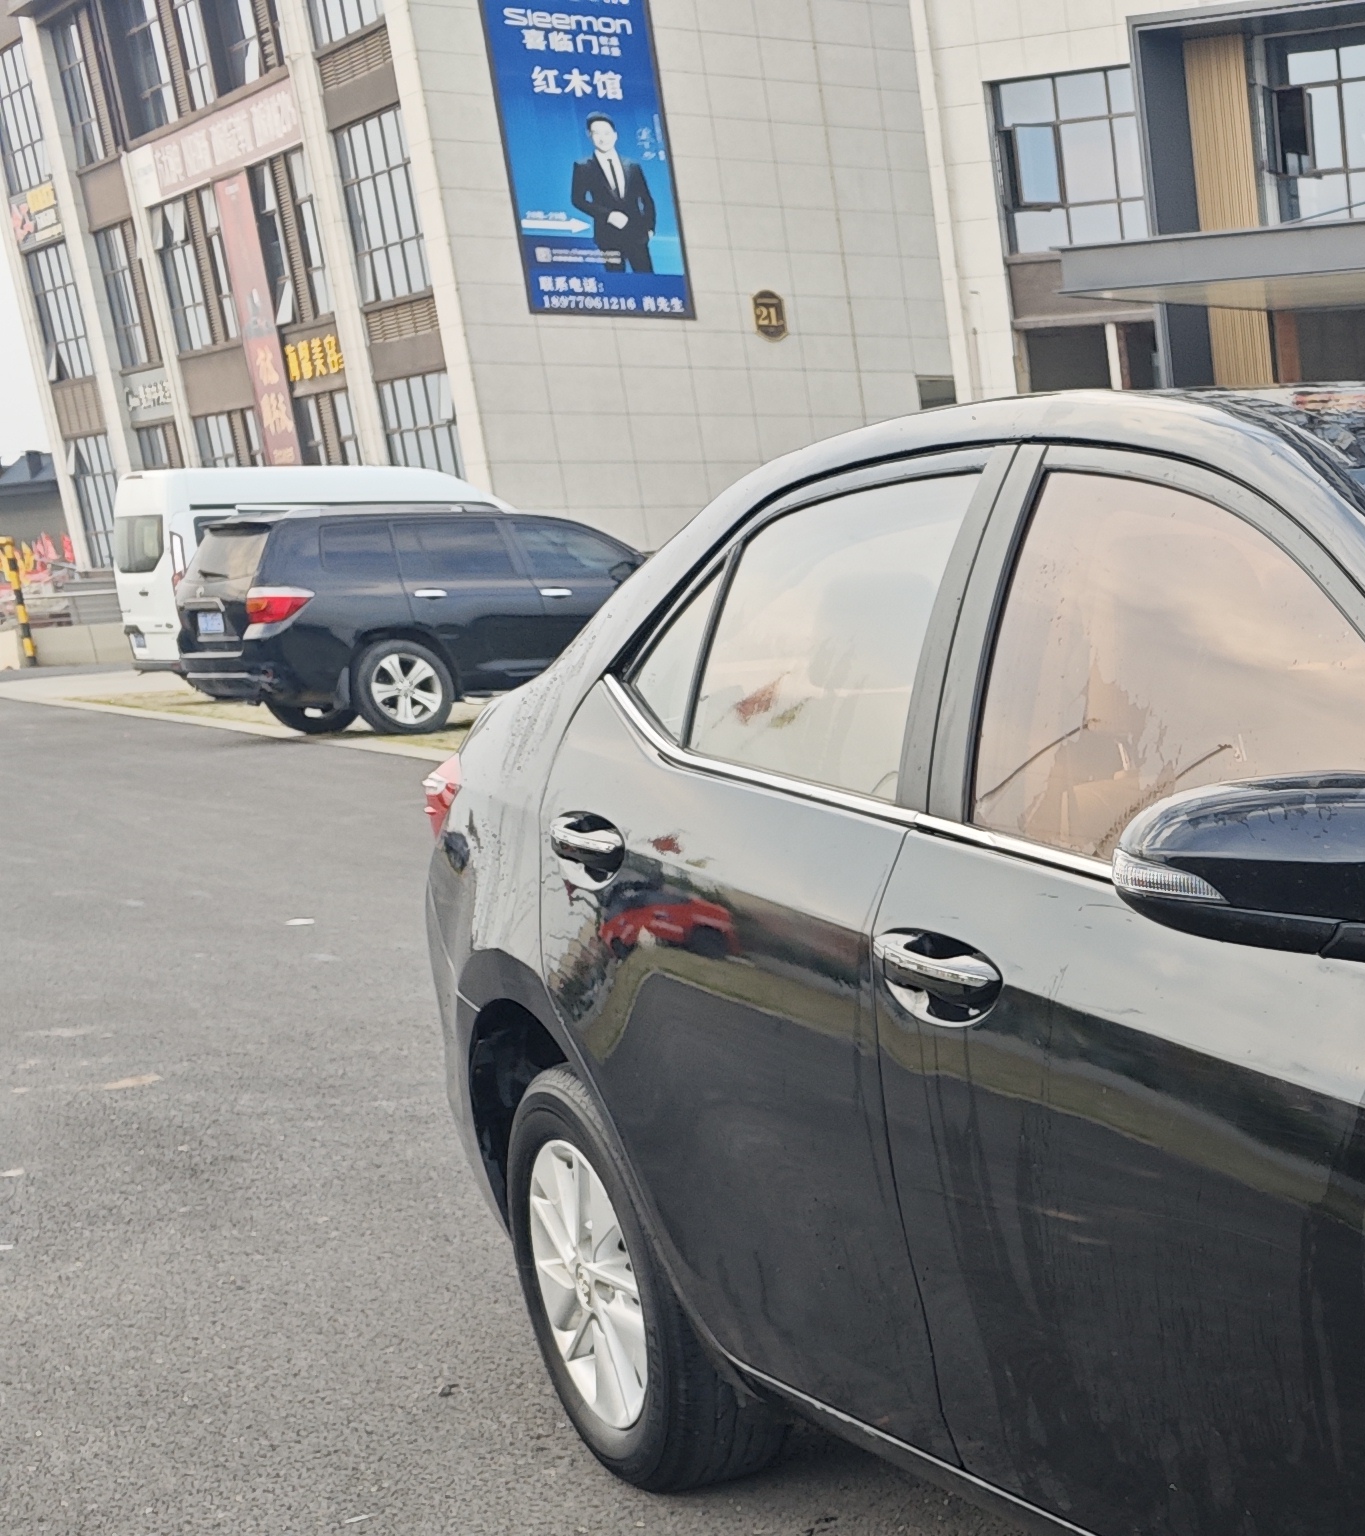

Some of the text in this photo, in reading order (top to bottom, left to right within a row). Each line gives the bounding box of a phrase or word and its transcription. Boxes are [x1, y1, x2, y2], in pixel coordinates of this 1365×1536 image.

[503, 7, 633, 35] Sleemon
[521, 29, 599, 54] 喜临门
[531, 65, 624, 100] 红木馆
